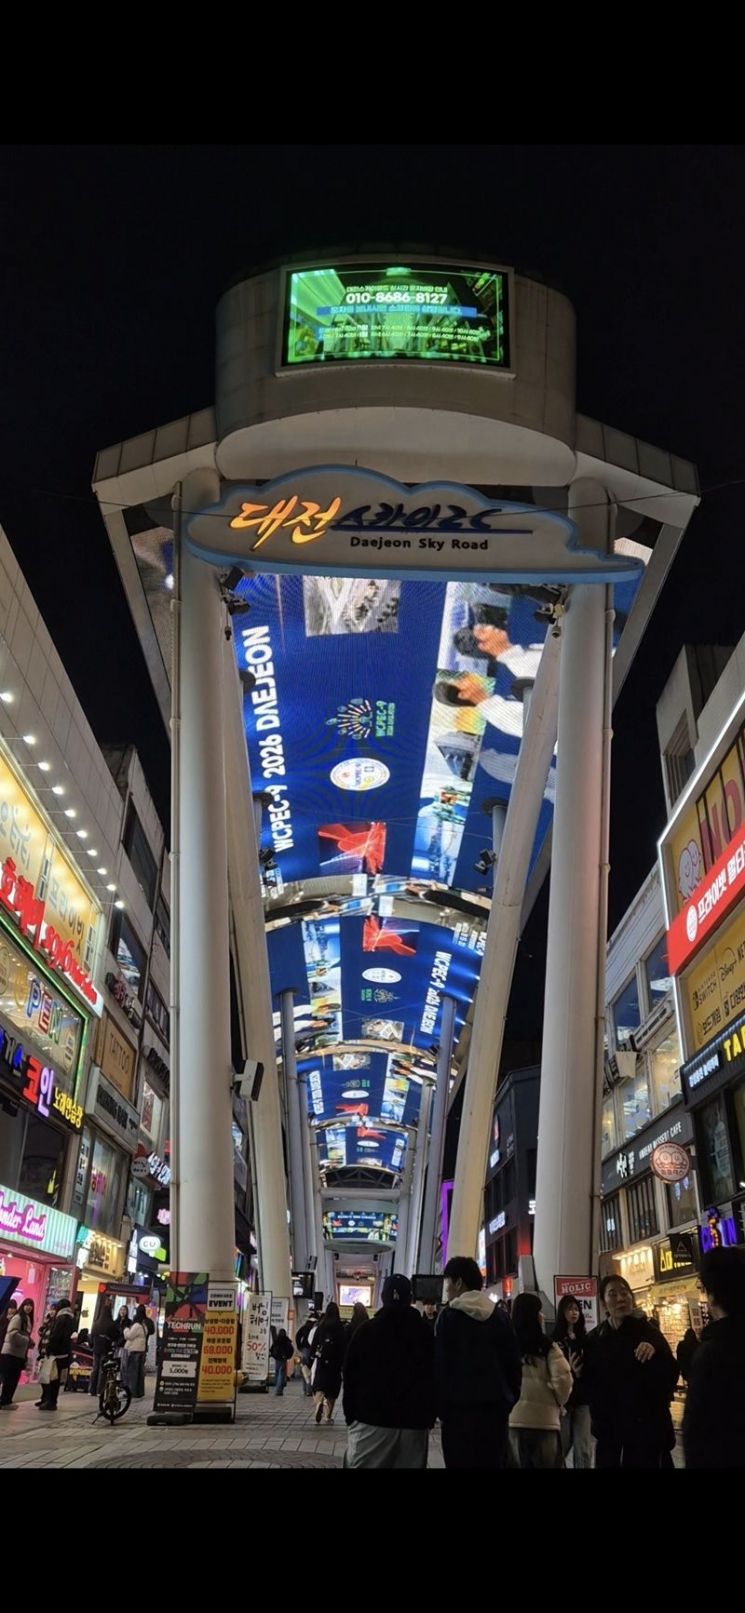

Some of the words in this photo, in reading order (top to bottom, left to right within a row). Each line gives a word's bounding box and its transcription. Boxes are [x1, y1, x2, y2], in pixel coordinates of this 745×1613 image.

[345, 291, 448, 305] 010-8686-8127
[230, 495, 342, 553] 대전
[350, 536, 412, 550] Daejeon
[418, 537, 446, 552] Sky
[451, 537, 489, 551] Road
[241, 624, 282, 732] DAEJEON
[258, 733, 287, 779] 2026
[264, 784, 295, 853] WCPEC-9
[22, 1054, 55, 1118] 코인
[53, 1087, 84, 1129] 노래연습장
[669, 1121, 682, 1138] CAFE
[22, 1206, 46, 1238] Land
[561, 1282, 592, 1294] HOLIC
[208, 1300, 233, 1308] EVENT
[246, 1341, 267, 1351] 50%
